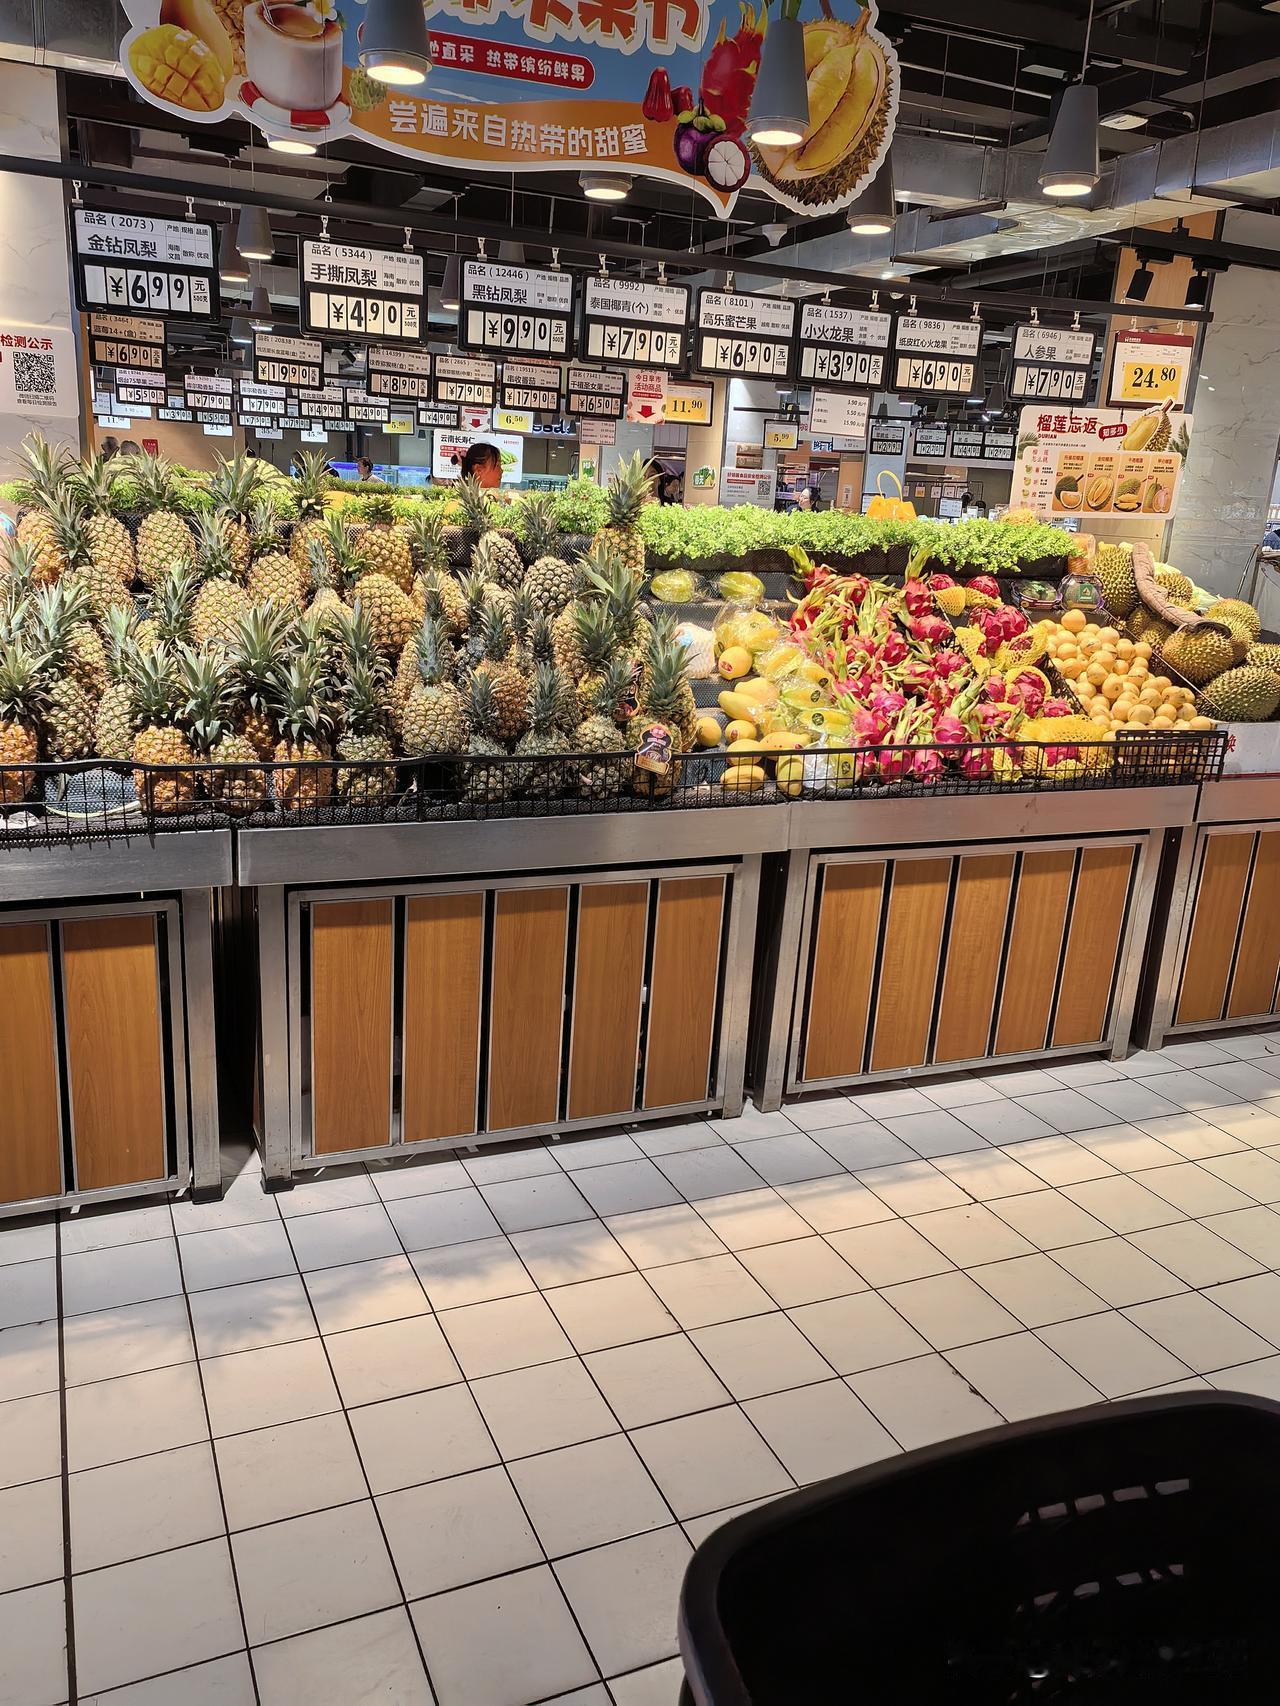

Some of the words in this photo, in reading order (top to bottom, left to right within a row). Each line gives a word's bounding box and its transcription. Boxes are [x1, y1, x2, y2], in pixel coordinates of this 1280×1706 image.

[486, 49, 585, 82] 热带缤纷鲜果
[389, 100, 649, 157] 尝遍来自热带的甜蜜
[166, 224, 179, 233] 产地
[87, 234, 158, 258] 金钻凤梨
[311, 262, 377, 287] 手撕凤梨
[109, 275, 185, 304] ¥6.99
[194, 280, 206, 292] 元
[472, 284, 527, 304] 黑钻凤梨
[332, 300, 397, 327] ¥4.90
[406, 307, 416, 318] 元
[590, 296, 649, 315] 泰国椰青(个)
[554, 323, 563, 333] 元
[703, 312, 757, 330] 高乐蜜芒果
[488, 318, 547, 344] ¥9.90
[804, 323, 854, 342] 小火龙果
[0, 334, 53, 350] 检测公示
[607, 330, 663, 355] ¥7.90
[669, 336, 677, 346] 元
[899, 337, 948, 349] 纸皮红心火龙果
[668, 349, 677, 358] 个
[720, 344, 771, 367] ¥6.90
[778, 348, 786, 358] 元
[1024, 344, 1057, 360] 人参果
[818, 354, 867, 377] ¥3.90
[873, 359, 880, 368] 元
[964, 367, 971, 375] 元
[636, 373, 661, 383] 今日早市
[872, 370, 879, 378] 个
[912, 363, 959, 386] ¥6.90
[1028, 371, 1072, 393] ¥7.90
[1077, 374, 1084, 383] 元
[1132, 367, 1176, 388] 24.80
[634, 383, 661, 392] 活动商品
[672, 399, 703, 413] 11.90
[505, 415, 523, 425] 6.50
[1036, 414, 1098, 435] 榴莲忘返
[440, 434, 476, 445] 云南长寿仁
[773, 433, 790, 443] 5.99
